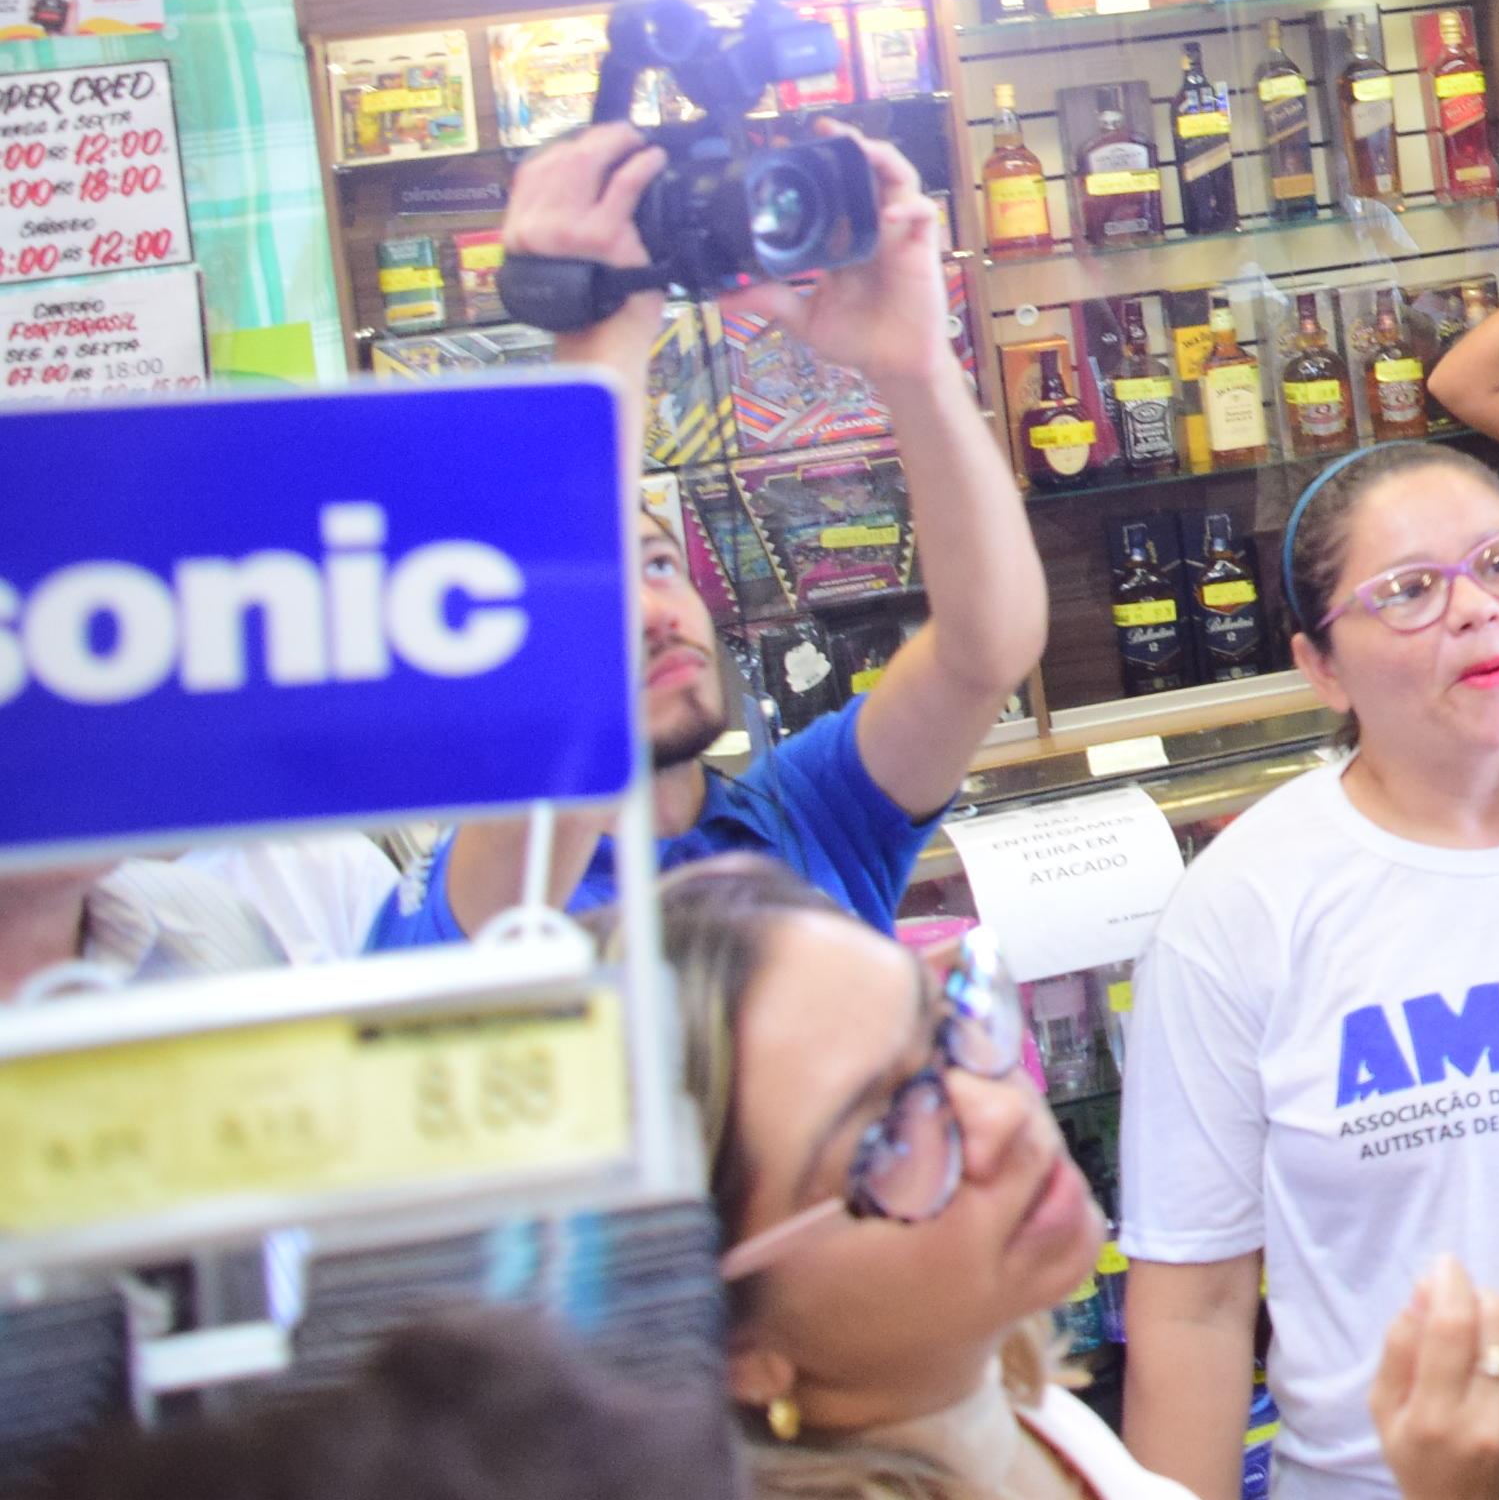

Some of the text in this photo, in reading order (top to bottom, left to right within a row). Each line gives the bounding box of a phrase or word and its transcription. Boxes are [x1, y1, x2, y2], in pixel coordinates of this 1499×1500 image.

[991, 814, 1136, 851] ENTREGAMOS
[1022, 833, 1119, 863] FEIRA EM
[1029, 852, 1129, 886] ATACADO
[1339, 1091, 1481, 1138] ASSOCIAÇÃO
[1359, 1122, 1467, 1161] AUTISTAS
